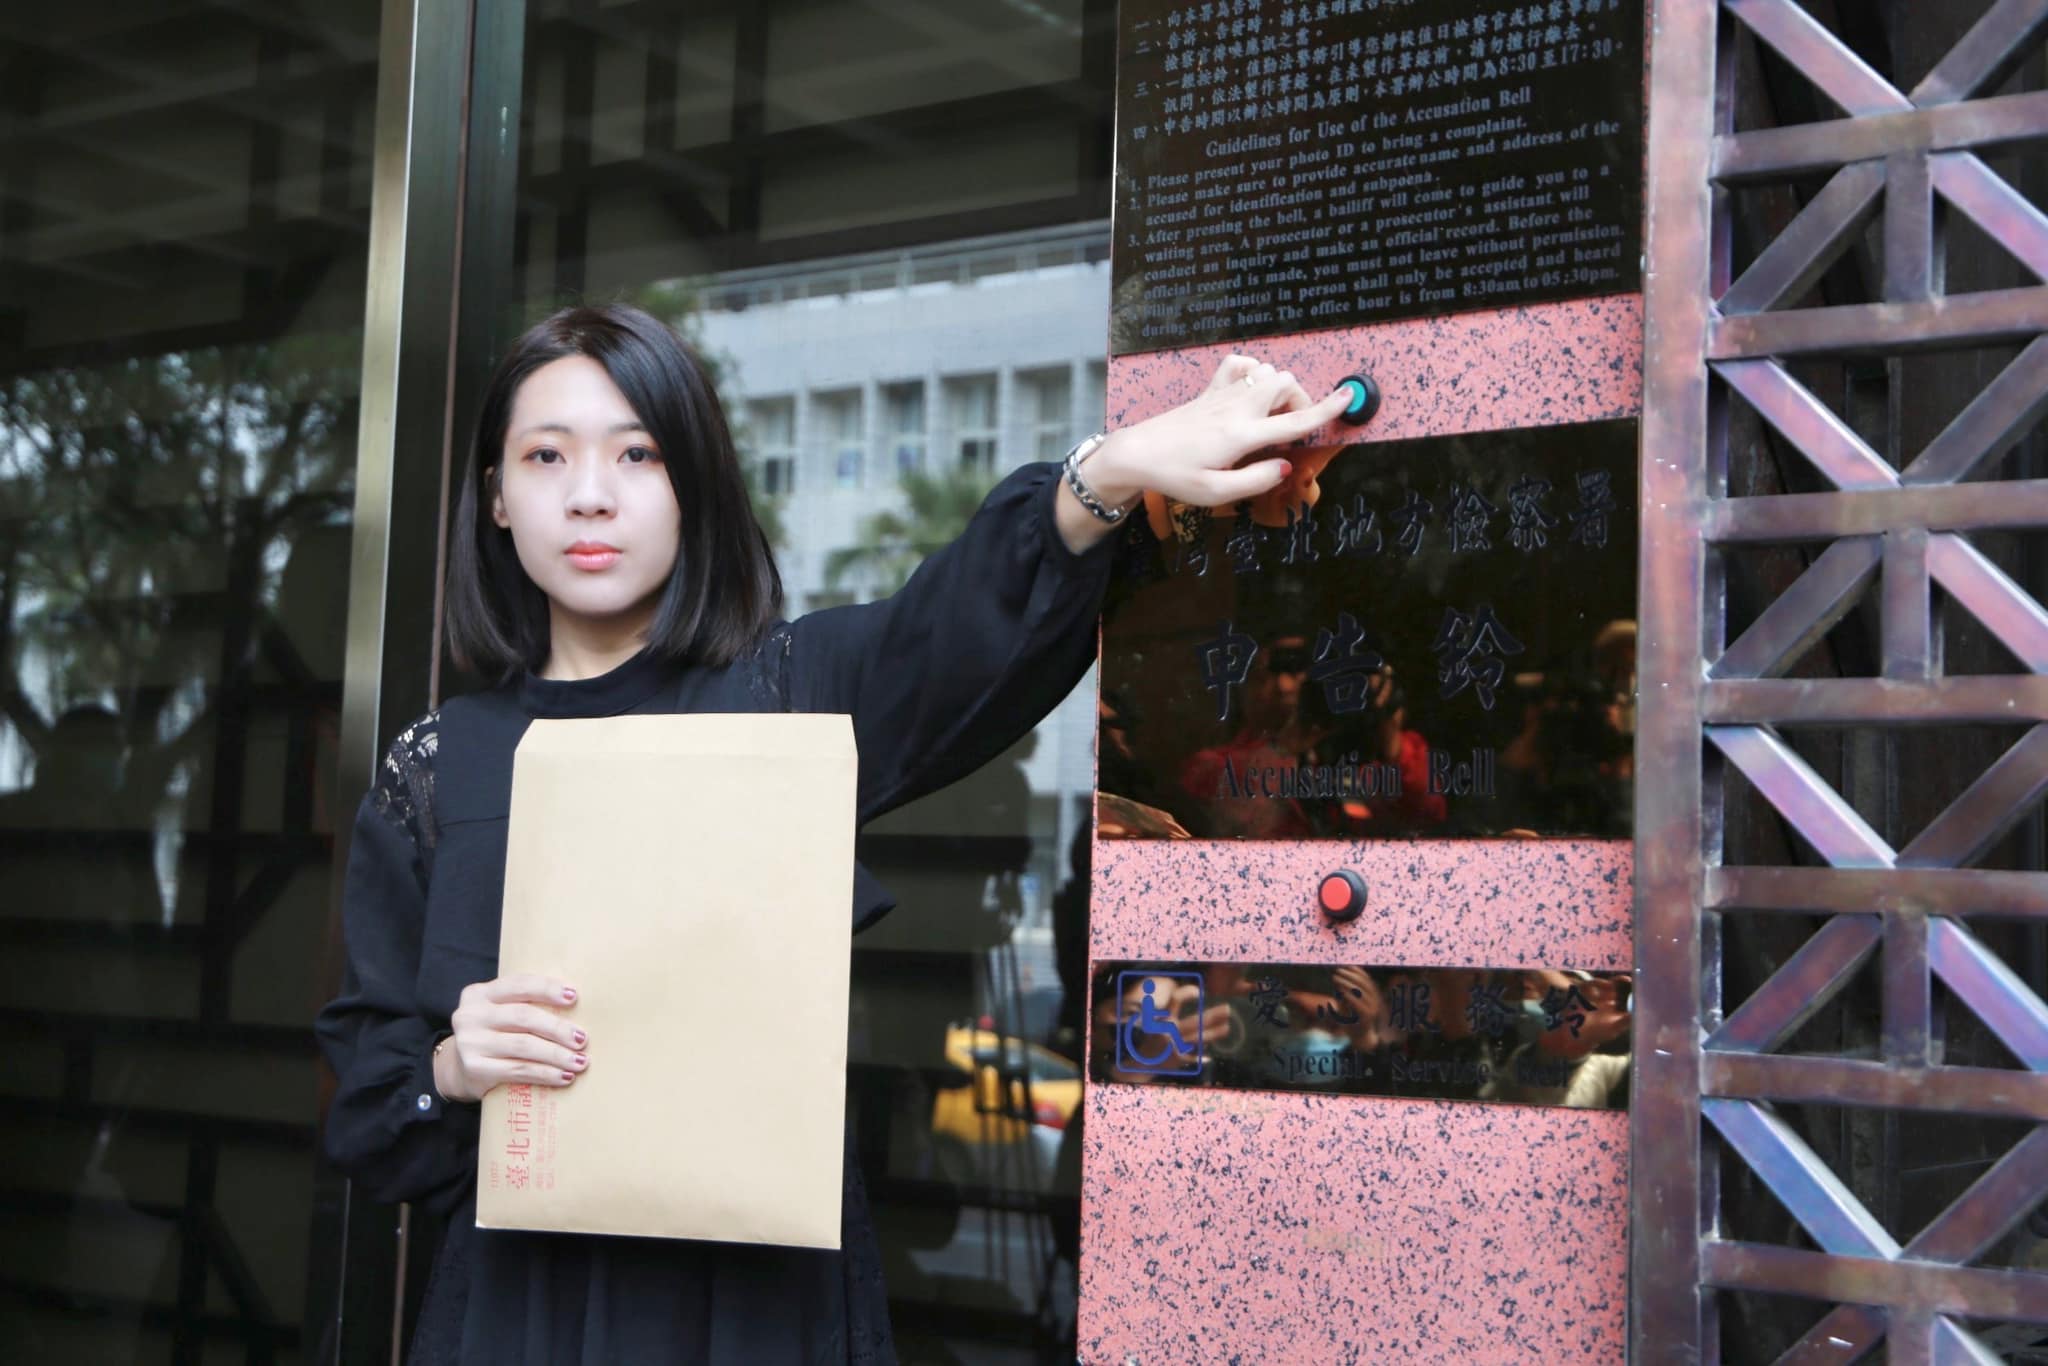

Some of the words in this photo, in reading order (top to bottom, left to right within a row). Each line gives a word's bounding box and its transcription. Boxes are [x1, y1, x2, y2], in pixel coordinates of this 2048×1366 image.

[1148, 174, 1188, 189] Please
[1195, 162, 1244, 184] present
[1250, 158, 1283, 175] your
[1289, 150, 1329, 169] photo
[1336, 143, 1354, 157] ID
[1361, 142, 1375, 154] to
[1382, 134, 1422, 150] bring
[1429, 132, 1438, 142] a
[1445, 116, 1526, 139] complaint.
[1206, 134, 1281, 157] Guidelines
[1288, 127, 1311, 143] for
[1317, 121, 1344, 138] Use
[1350, 114, 1367, 132] of
[1373, 111, 1397, 128] the
[1405, 96, 1490, 122] Accusation
[1499, 86, 1530, 107] Bell
[1146, 206, 1197, 225] accused
[1203, 203, 1224, 217] for
[1230, 189, 1322, 212] identification
[1329, 181, 1356, 197] and
[1363, 171, 1439, 191] subpoena.
[1148, 192, 1188, 207] Please
[1194, 184, 1230, 200] make
[1236, 179, 1266, 193] sure
[1272, 176, 1286, 187] to
[1292, 164, 1346, 187] provide
[1353, 155, 1416, 174] accurate
[1419, 148, 1459, 163] name
[1466, 138, 1495, 156] and
[1503, 131, 1562, 150] address
[1570, 123, 1587, 139] of
[1594, 120, 1619, 135] the
[1144, 246, 1194, 262] waiting
[1200, 242, 1233, 255] area.
[1239, 236, 1250, 249] A
[1256, 226, 1331, 250] prosecutor
[1337, 223, 1354, 235] or
[1360, 221, 1368, 231] a
[1484, 193, 1551, 213] assistant
[1559, 185, 1588, 201] will
[1145, 229, 1180, 244] After
[1186, 220, 1242, 241] pressing
[1248, 215, 1270, 228] the
[1277, 208, 1307, 224] bell,
[1313, 208, 1322, 219] a
[1329, 197, 1374, 216] bailiff
[1380, 192, 1407, 208] will
[1414, 189, 1452, 203] come
[1460, 185, 1475, 197] to
[1482, 175, 1524, 197] guide
[1536, 172, 1564, 189] you
[1572, 168, 1588, 180] to
[1600, 165, 1609, 176] a
[1144, 264, 1196, 281] conduct
[1203, 262, 1219, 273] an
[1226, 253, 1277, 271] inquiry
[1283, 245, 1309, 262] and
[1316, 241, 1354, 257] make
[1361, 239, 1378, 250] an
[1385, 227, 1438, 247] official
[1445, 219, 1500, 238] record.
[1508, 213, 1559, 229] Before
[1567, 207, 1592, 221] the
[1144, 280, 1191, 301] official
[1197, 274, 1241, 291] record
[1247, 272, 1259, 285] is
[1265, 267, 1307, 283] made,
[1313, 264, 1339, 280] you
[1346, 256, 1381, 272] must
[1389, 252, 1412, 266] not
[1420, 247, 1458, 262] leave
[1465, 237, 1524, 255] without
[1532, 225, 1624, 250] permission.
[1188, 292, 1271, 312] complaint(s)
[1278, 287, 1291, 300] in
[1298, 283, 1346, 302] person
[1353, 273, 1388, 291] shall
[1395, 269, 1427, 286] only
[1435, 266, 1453, 280] be
[1460, 255, 1527, 276] accepted
[1536, 250, 1565, 266] and
[1574, 243, 1620, 261] heard
[1193, 316, 1230, 330] office
[1237, 312, 1273, 325] hour.
[1276, 305, 1303, 320] The
[1310, 300, 1350, 316] office
[1357, 296, 1392, 310] hour
[1399, 291, 1411, 304] is
[1419, 288, 1455, 302] from
[1523, 277, 1538, 288] to
[1128, 467, 1618, 577] 灣臺北地方檢察署
[1199, 604, 1526, 722] 申告鈴
[1216, 750, 1404, 801] Accusation
[1426, 747, 1497, 798] Bell
[1249, 976, 1598, 1038] 愛心服務鈴
[1391, 1053, 1490, 1086] Service
